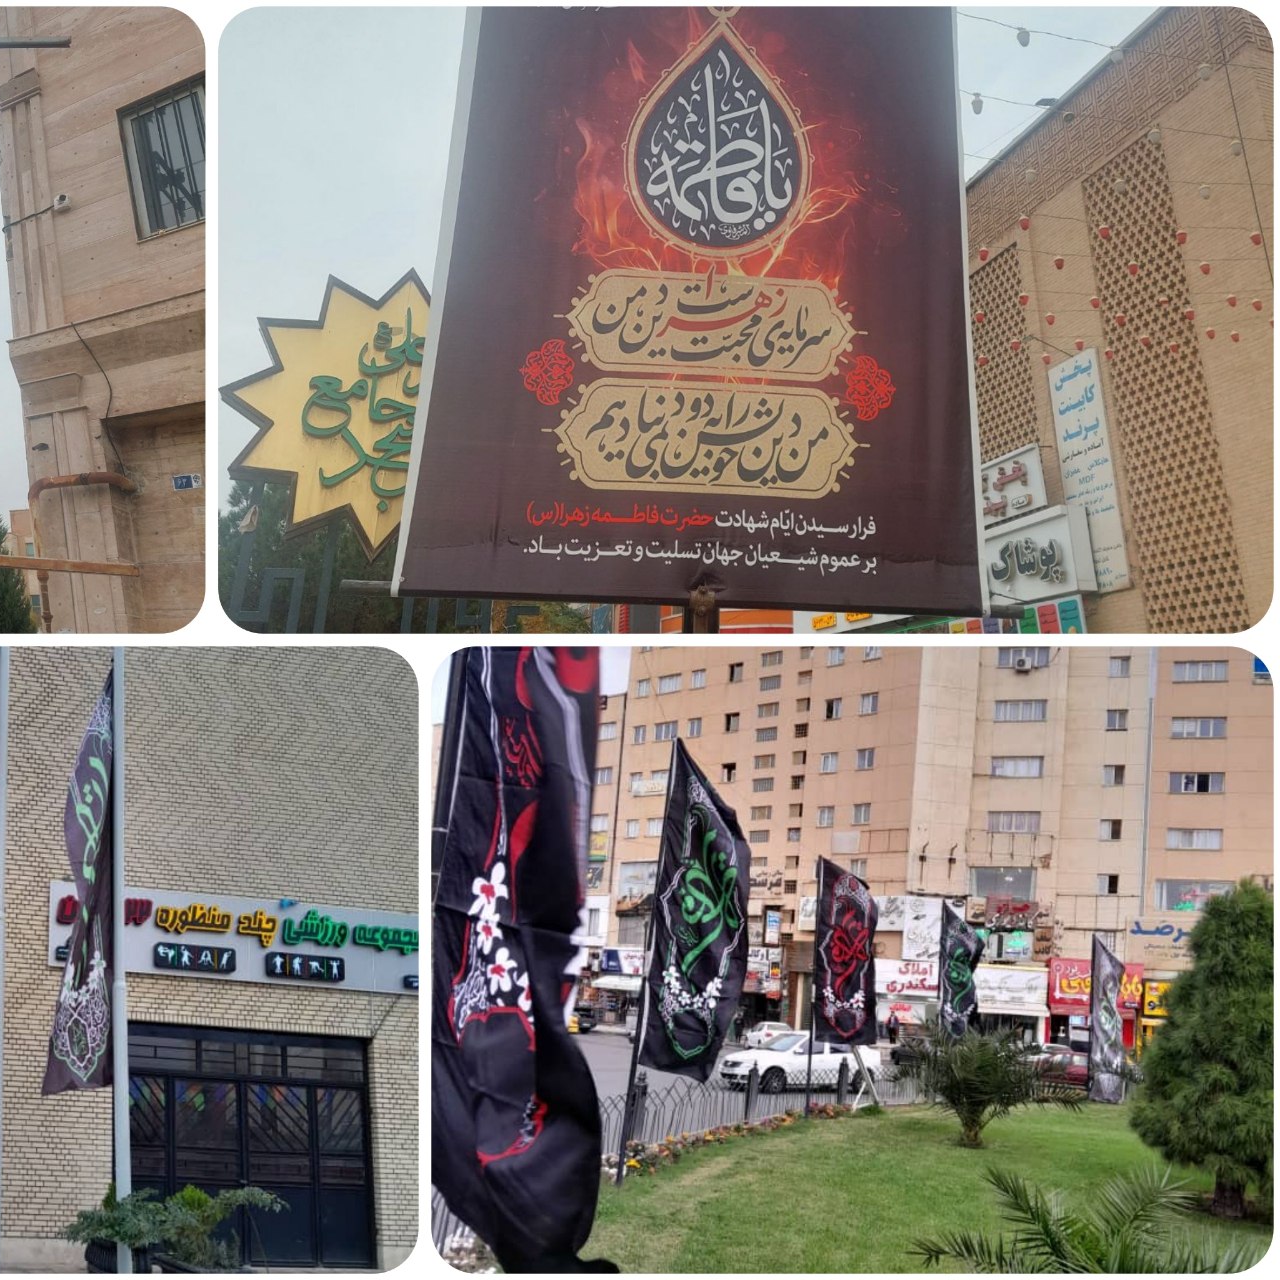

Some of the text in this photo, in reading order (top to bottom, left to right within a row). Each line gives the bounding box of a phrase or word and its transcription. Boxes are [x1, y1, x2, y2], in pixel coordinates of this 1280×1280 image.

[1055, 359, 1093, 392] پخش
[1058, 384, 1095, 416] کابینت
[1062, 417, 1100, 442] پرند
[660, 504, 714, 531] حضرت
[715, 509, 769, 529] شهادت
[570, 538, 632, 562] تعزیت
[645, 539, 701, 565] تسلیت
[702, 543, 743, 565] جهان
[746, 546, 818, 571] شیعیان
[820, 551, 861, 575] عموم
[991, 538, 1064, 583] پوشاک
[156, 903, 233, 935] منظوره
[237, 910, 277, 948] چند
[283, 909, 350, 946] ورزشی
